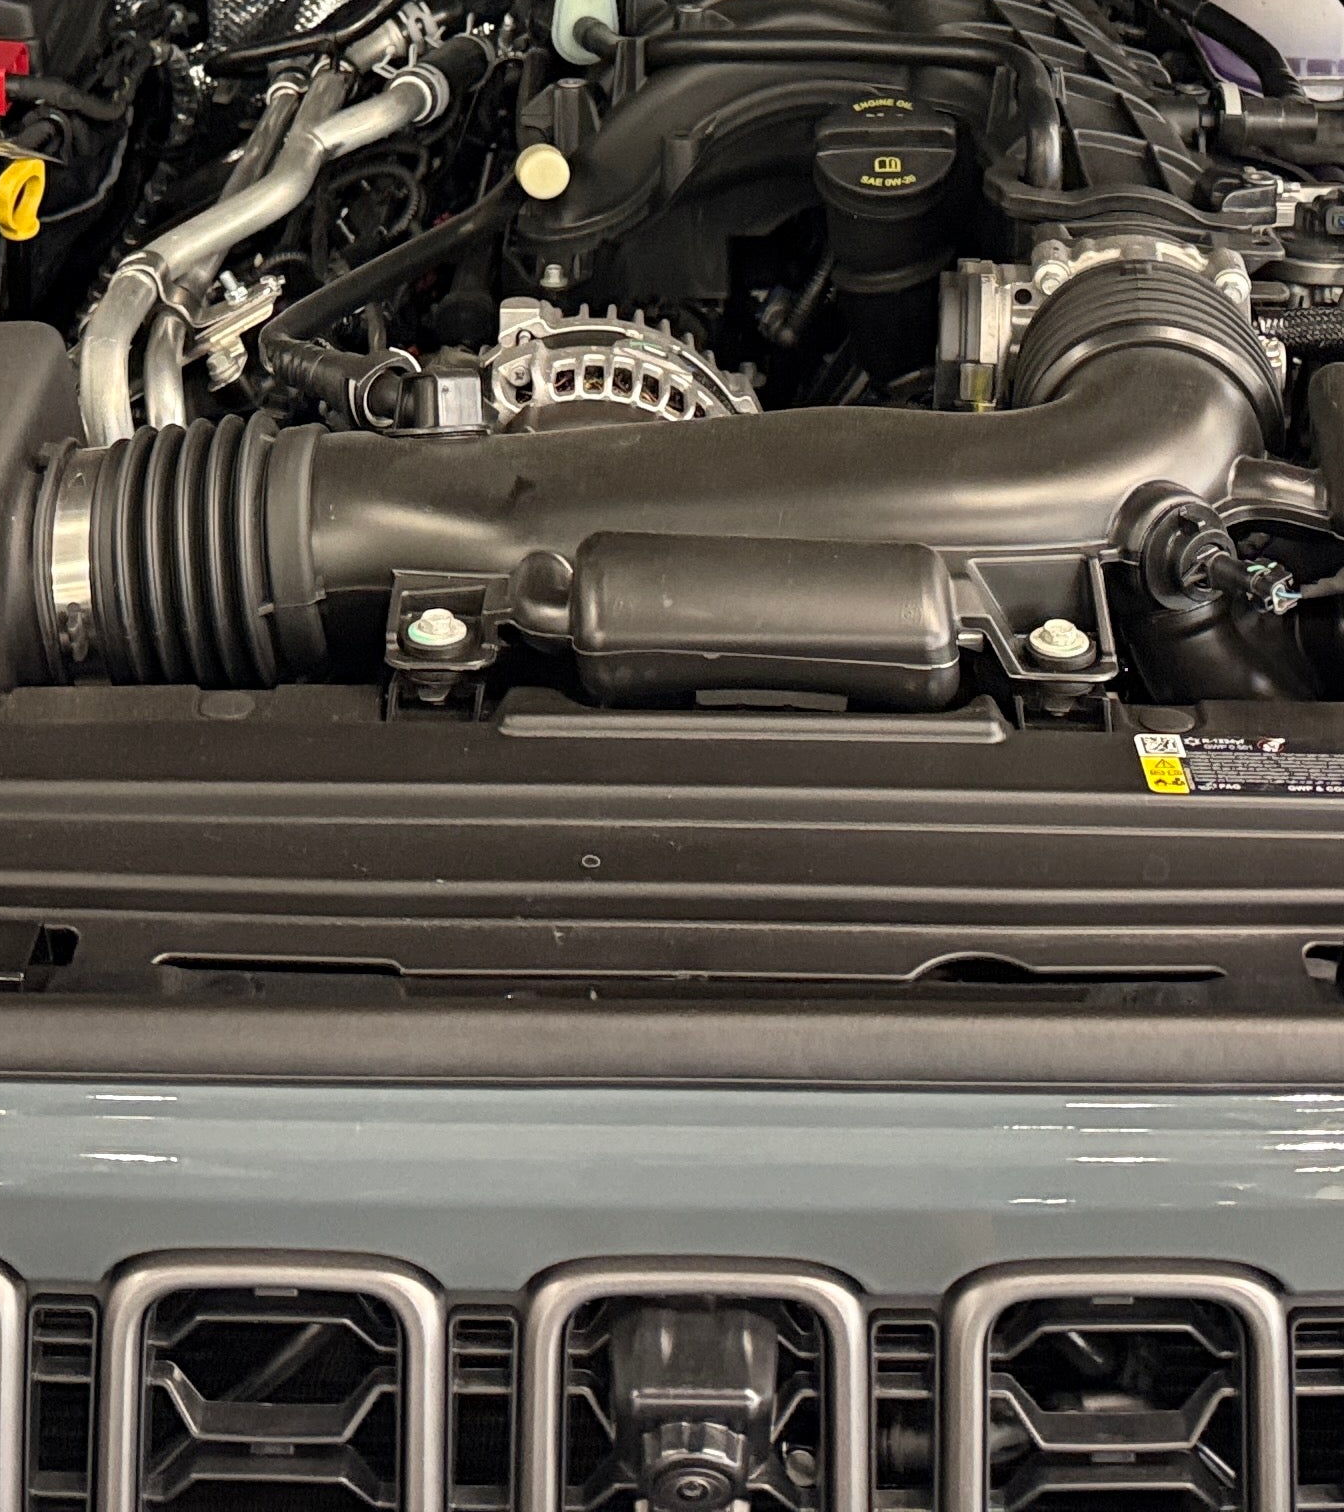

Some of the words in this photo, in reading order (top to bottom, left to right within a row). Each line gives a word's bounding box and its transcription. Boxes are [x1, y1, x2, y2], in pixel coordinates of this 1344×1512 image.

[853, 98, 894, 112] ENGINE
[896, 99, 914, 111] OIL
[860, 175, 883, 187] SAE
